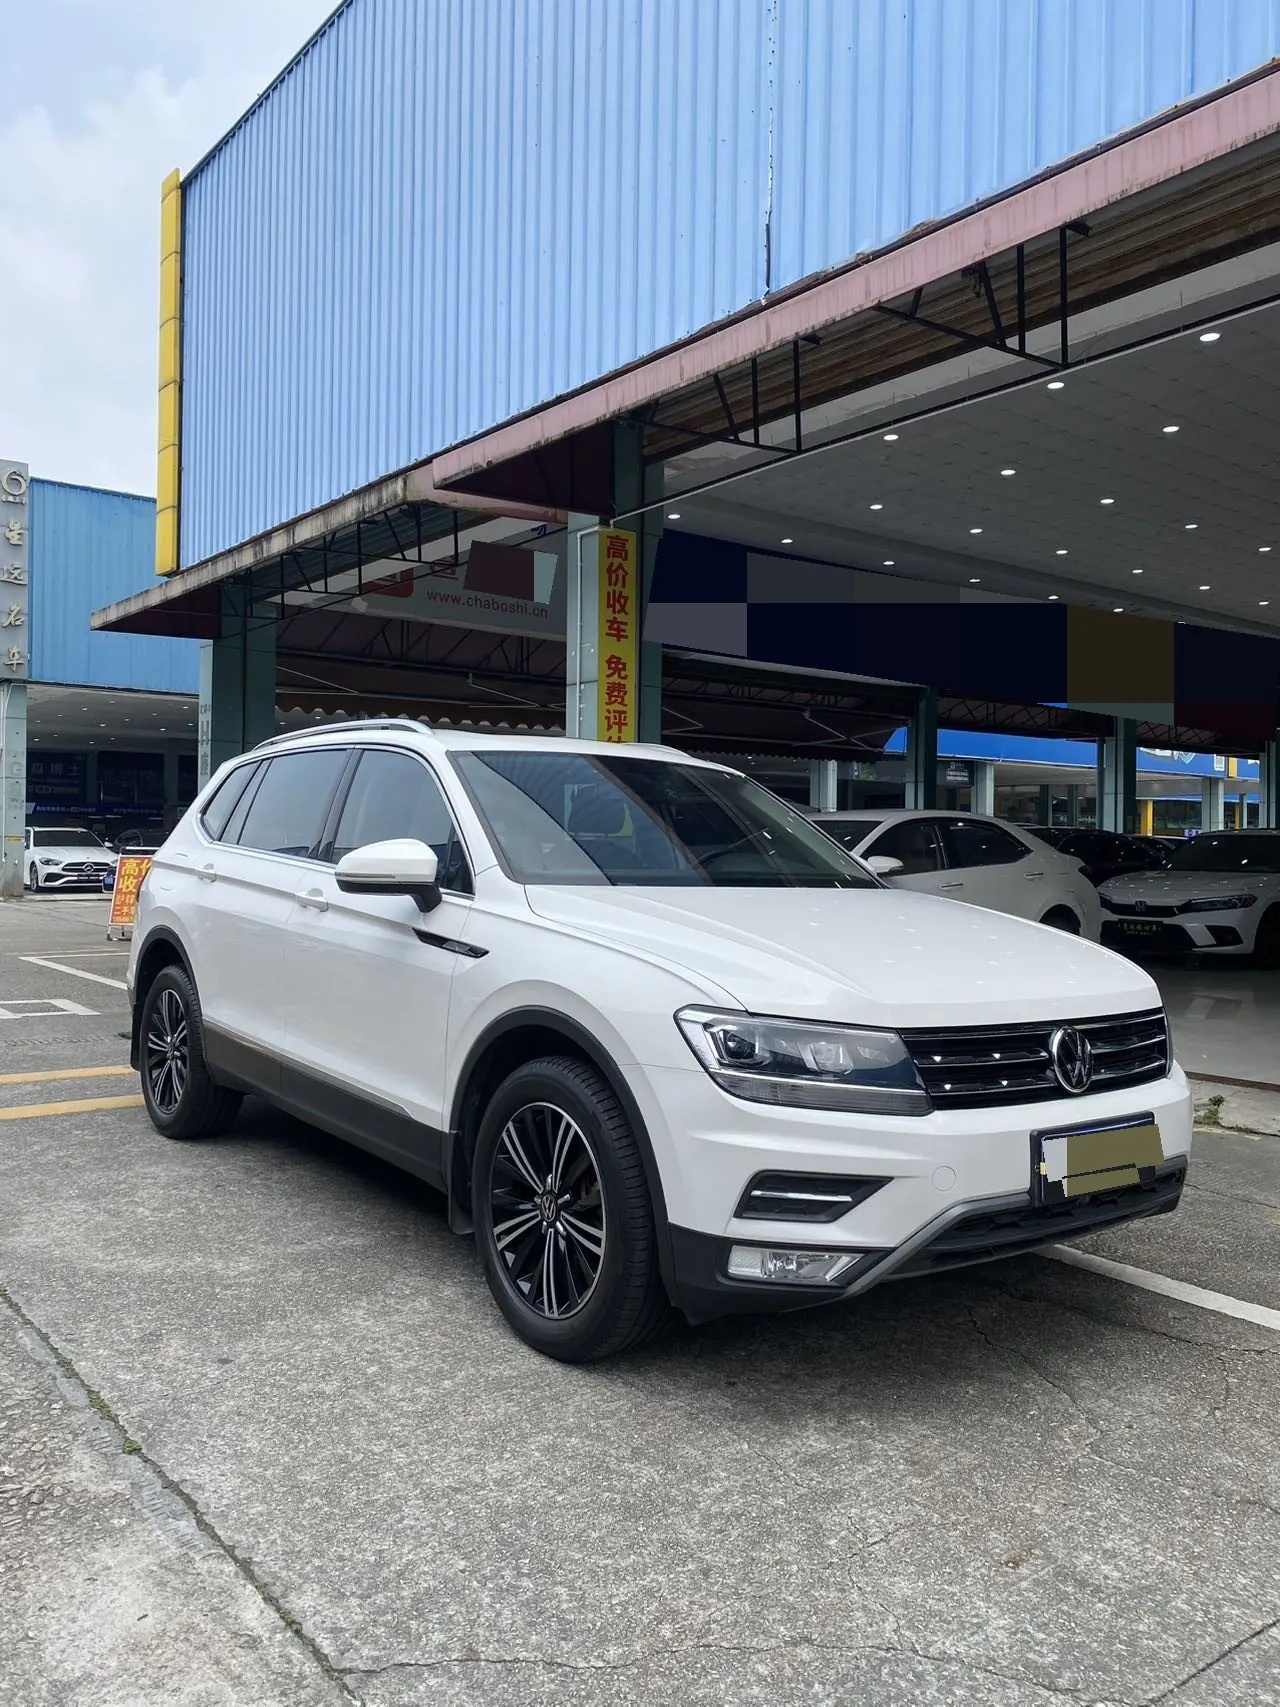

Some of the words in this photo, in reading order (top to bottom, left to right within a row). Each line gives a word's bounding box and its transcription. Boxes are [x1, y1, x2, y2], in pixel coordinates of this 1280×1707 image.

[426, 589, 548, 618] www.chaboshi.cn
[606, 535, 629, 643] 高价收车
